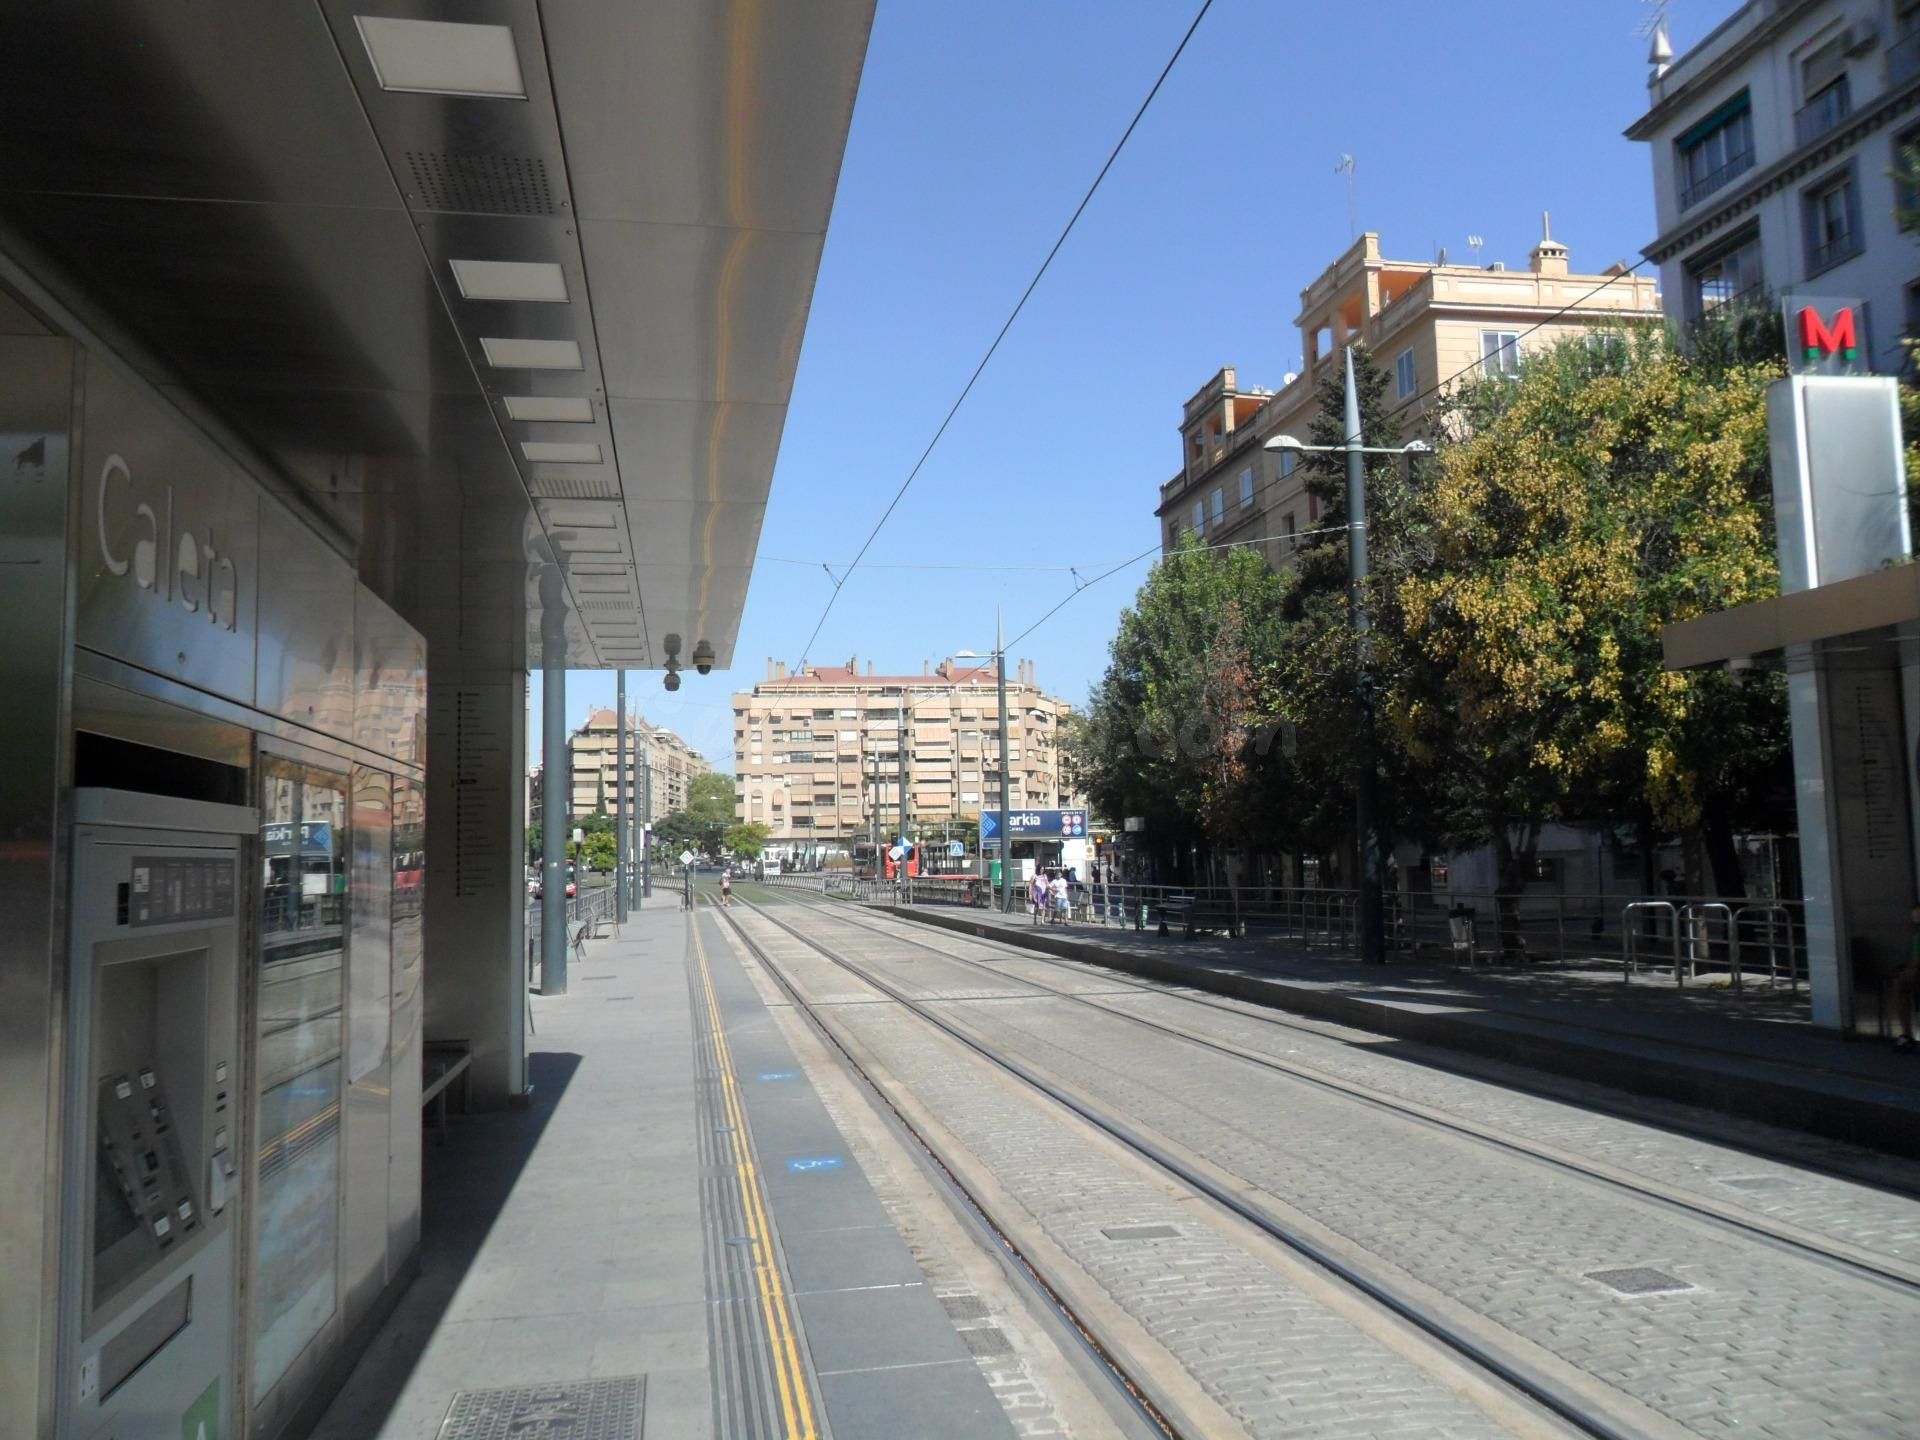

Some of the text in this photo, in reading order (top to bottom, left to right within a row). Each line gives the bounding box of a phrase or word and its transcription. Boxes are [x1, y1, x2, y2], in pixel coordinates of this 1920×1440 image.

[1798, 304, 1857, 361] M
[98, 454, 237, 633] Caleta
[1009, 813, 1041, 826] arkia
